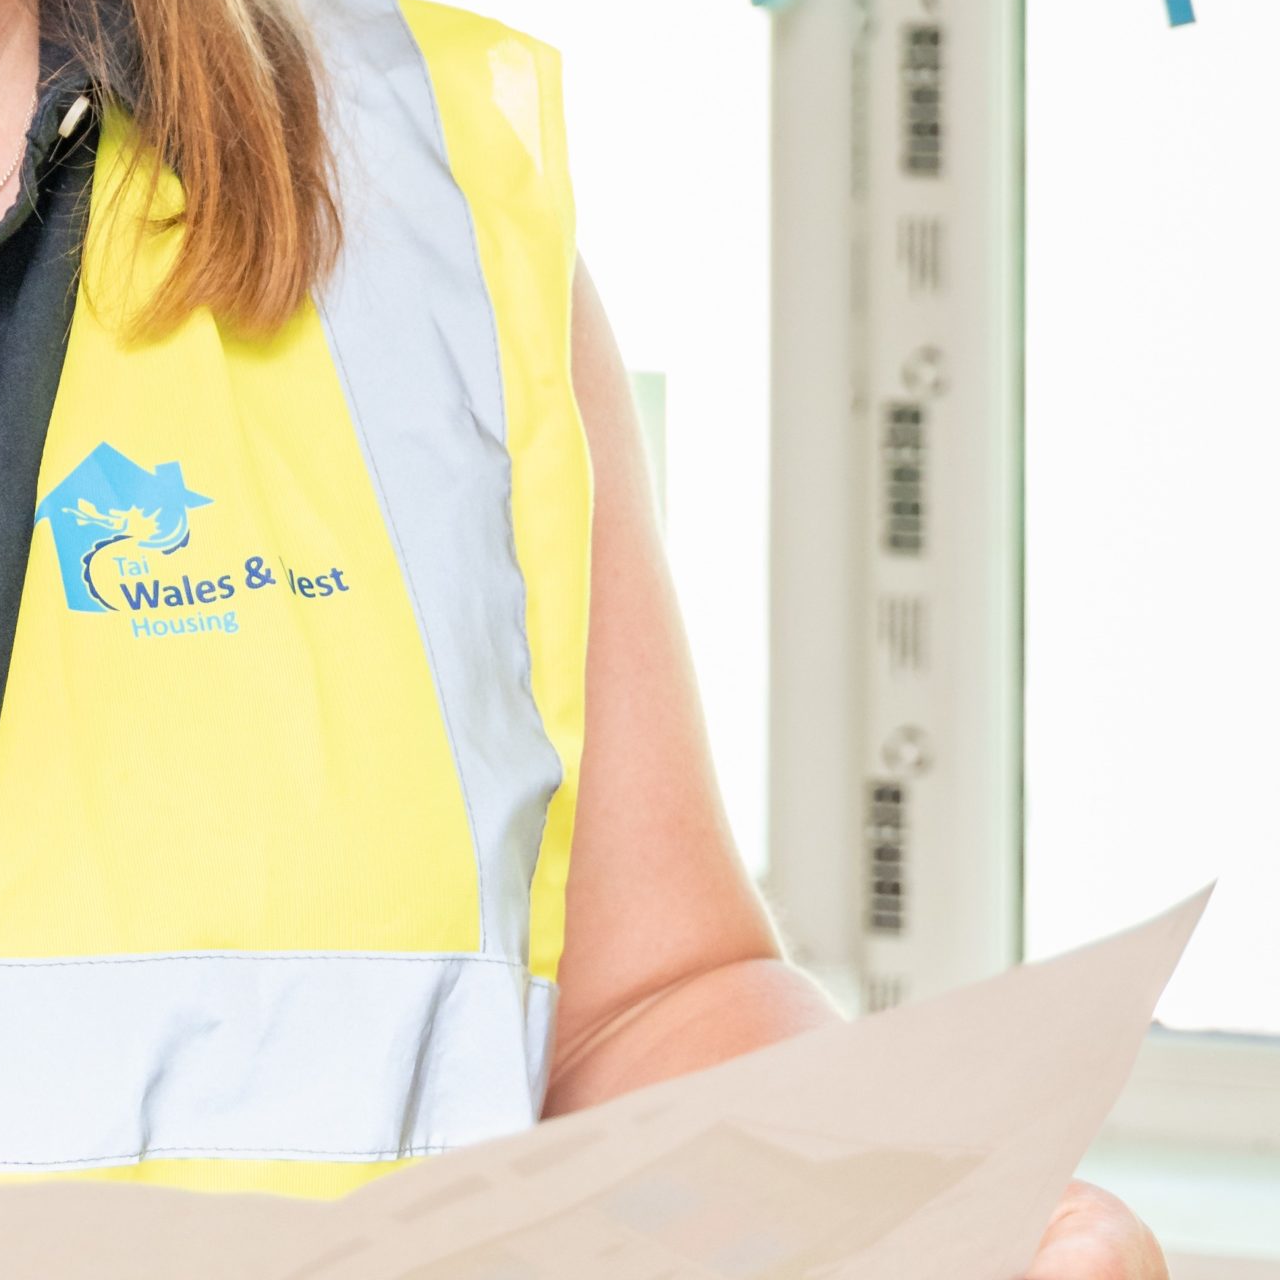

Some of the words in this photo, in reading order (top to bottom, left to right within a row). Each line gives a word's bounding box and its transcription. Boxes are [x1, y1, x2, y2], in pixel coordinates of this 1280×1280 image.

[113, 556, 149, 576] Tai
[120, 574, 235, 611] Wales
[243, 556, 276, 590] &
[132, 611, 238, 638] Housing
